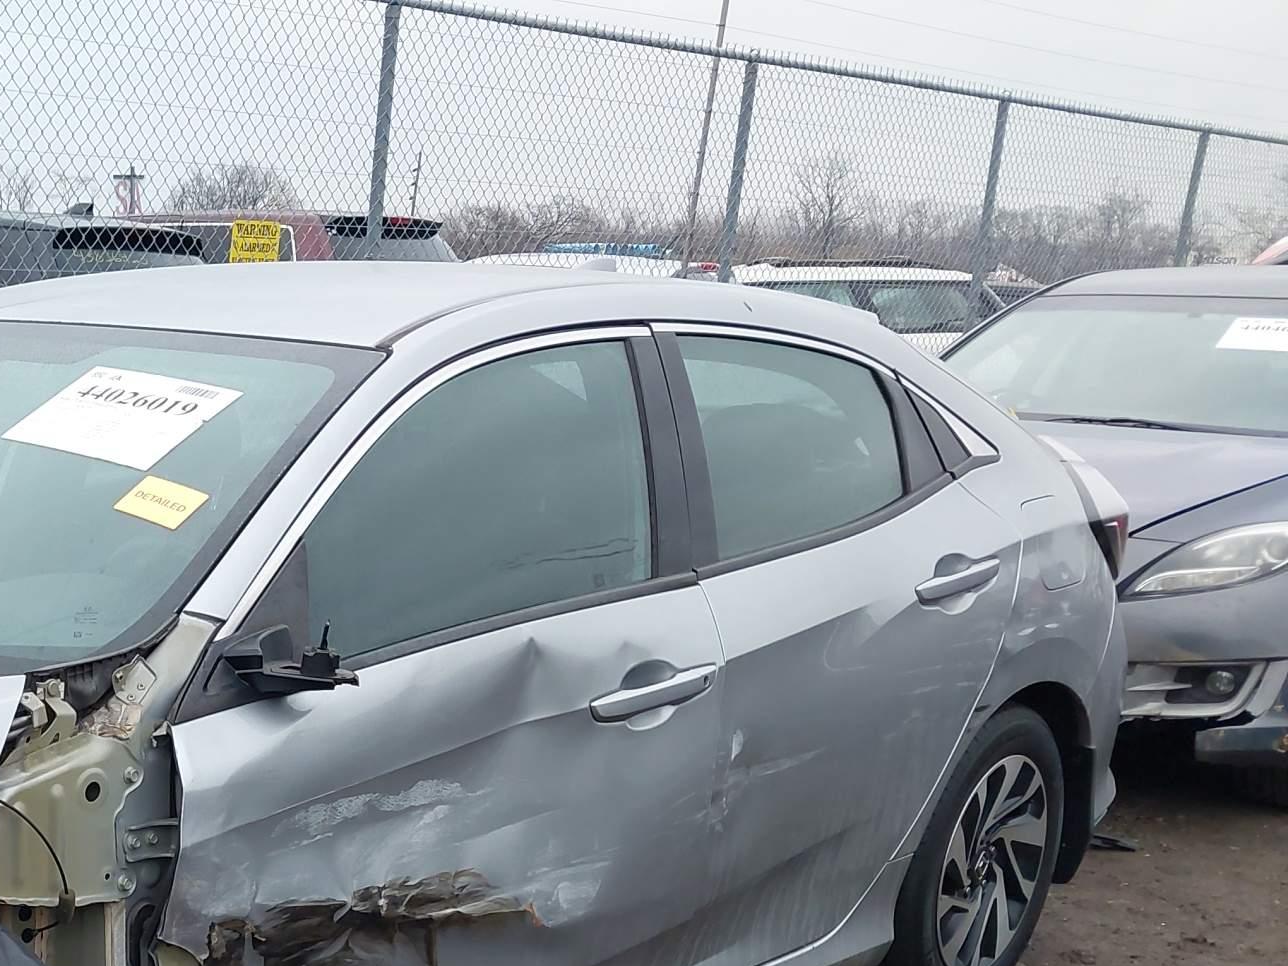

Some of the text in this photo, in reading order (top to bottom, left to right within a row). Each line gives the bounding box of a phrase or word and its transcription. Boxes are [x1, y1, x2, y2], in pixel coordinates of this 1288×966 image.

[236, 223, 278, 237] WARNING
[77, 385, 199, 416] 44026019
[134, 490, 187, 512] DETAILED
